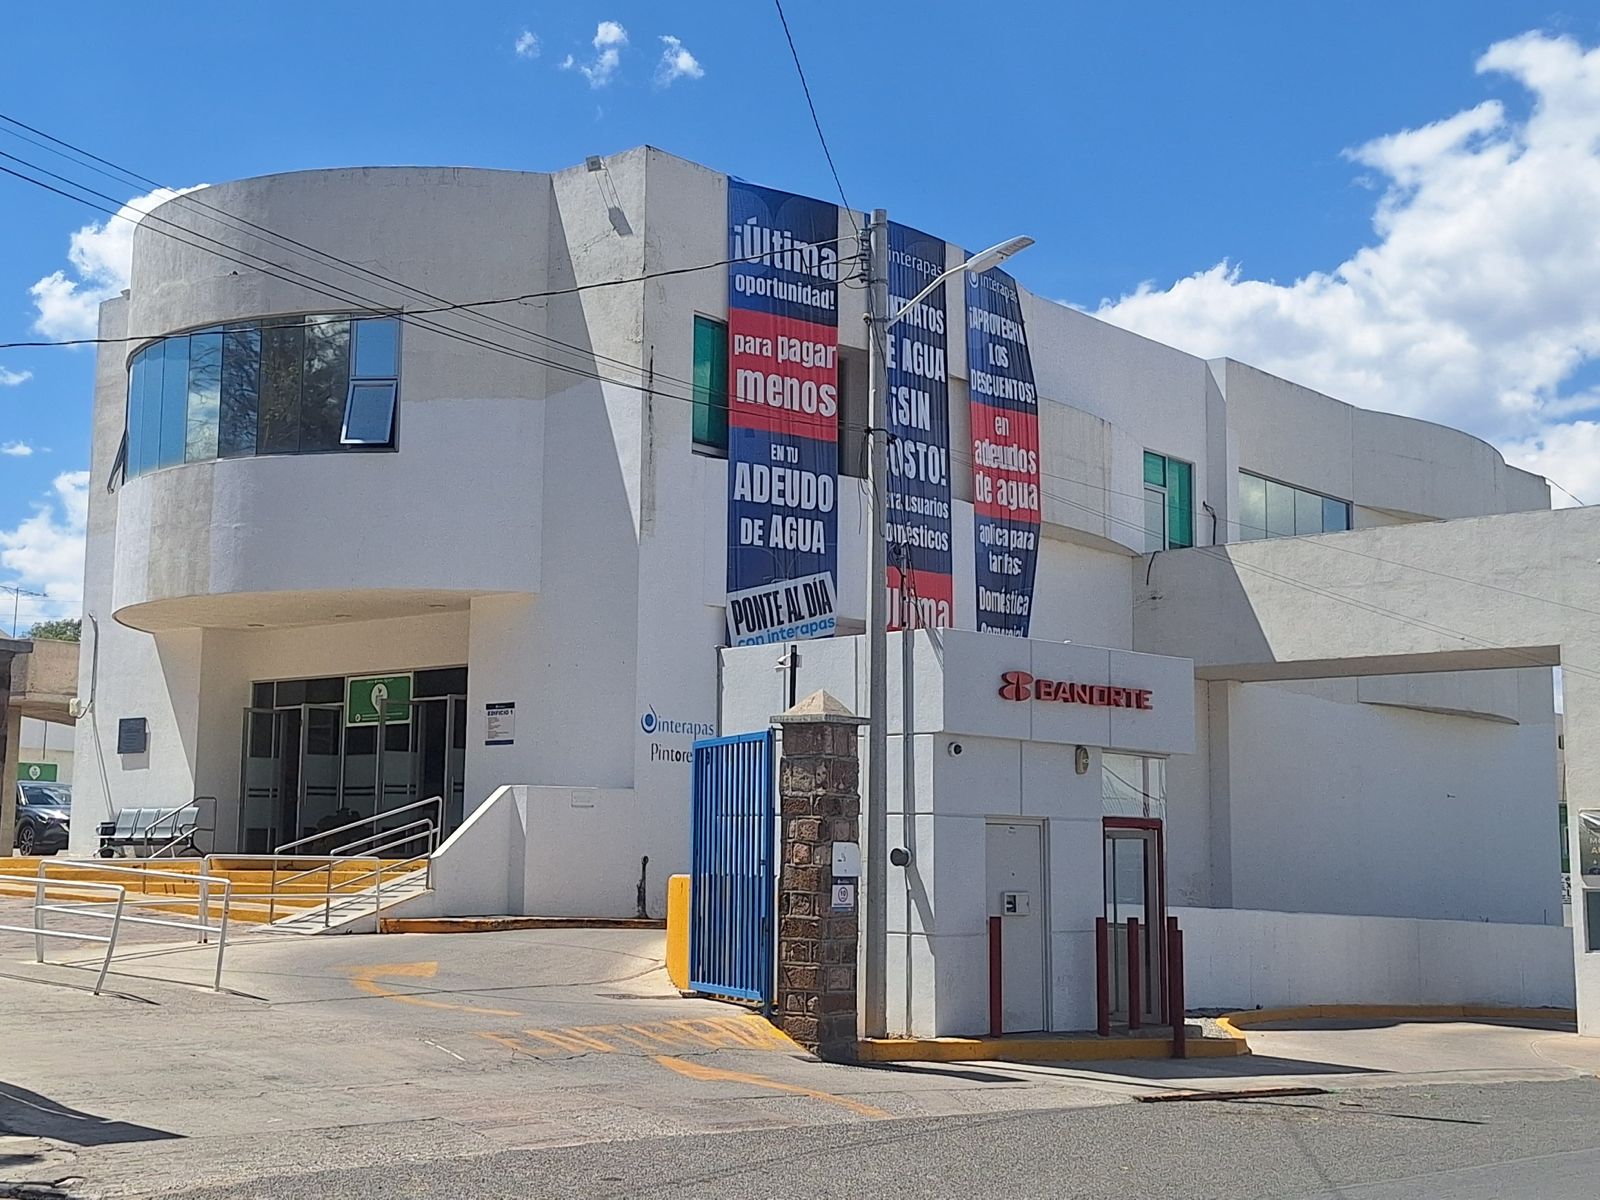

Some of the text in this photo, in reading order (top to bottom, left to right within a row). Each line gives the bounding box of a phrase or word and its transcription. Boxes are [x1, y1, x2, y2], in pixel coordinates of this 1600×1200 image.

[733, 216, 837, 281] ¡Última
[888, 244, 943, 280] interapas
[735, 274, 835, 310] oportunidad!
[734, 334, 837, 368] para pagar
[902, 337, 946, 383] AGUA
[988, 342, 1009, 368] LOS
[736, 368, 837, 417] menos
[970, 368, 1036, 404] DESCUENTOS!
[890, 386, 931, 431] ¡SIN
[994, 415, 1010, 436] en
[771, 443, 799, 464] EN TU
[886, 437, 947, 487] OSTO!
[974, 439, 1037, 474] adeudos
[733, 461, 834, 513] ADEUDO
[975, 471, 1039, 511] de agua
[904, 496, 949, 519] usuarios
[740, 514, 825, 554] DE AGUA
[979, 524, 1035, 551] aplica para
[730, 577, 833, 636] PONTE AL DÍA
[979, 586, 1030, 616] Doméstica
[766, 617, 836, 641] interapas
[1035, 679, 1153, 711] BANORTE
[658, 715, 715, 741] interapas
[651, 743, 694, 764] Pintore
